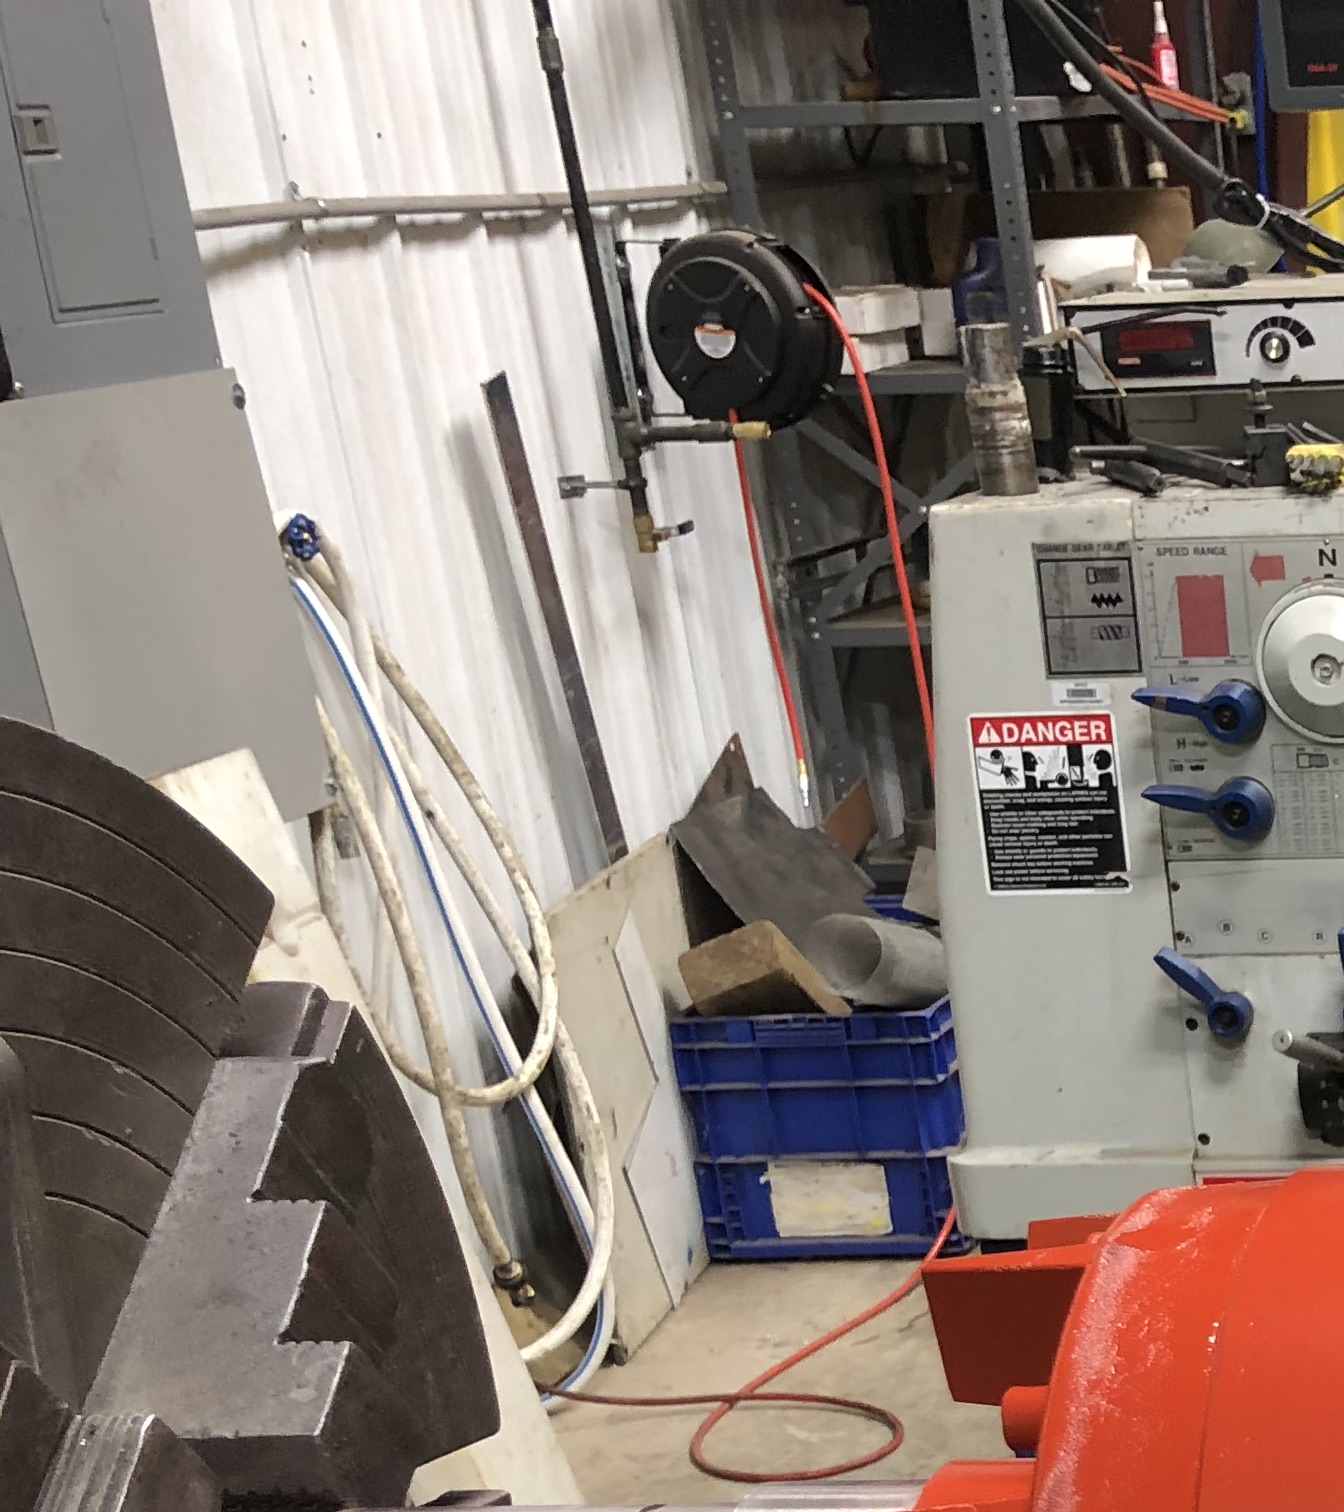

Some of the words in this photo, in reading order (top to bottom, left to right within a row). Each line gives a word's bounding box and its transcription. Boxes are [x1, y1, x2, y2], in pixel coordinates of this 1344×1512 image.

[1156, 547, 1189, 556] SPEED
[1193, 546, 1228, 556] RANGE
[1318, 548, 1338, 567] N
[1001, 720, 1107, 744] DANGER
